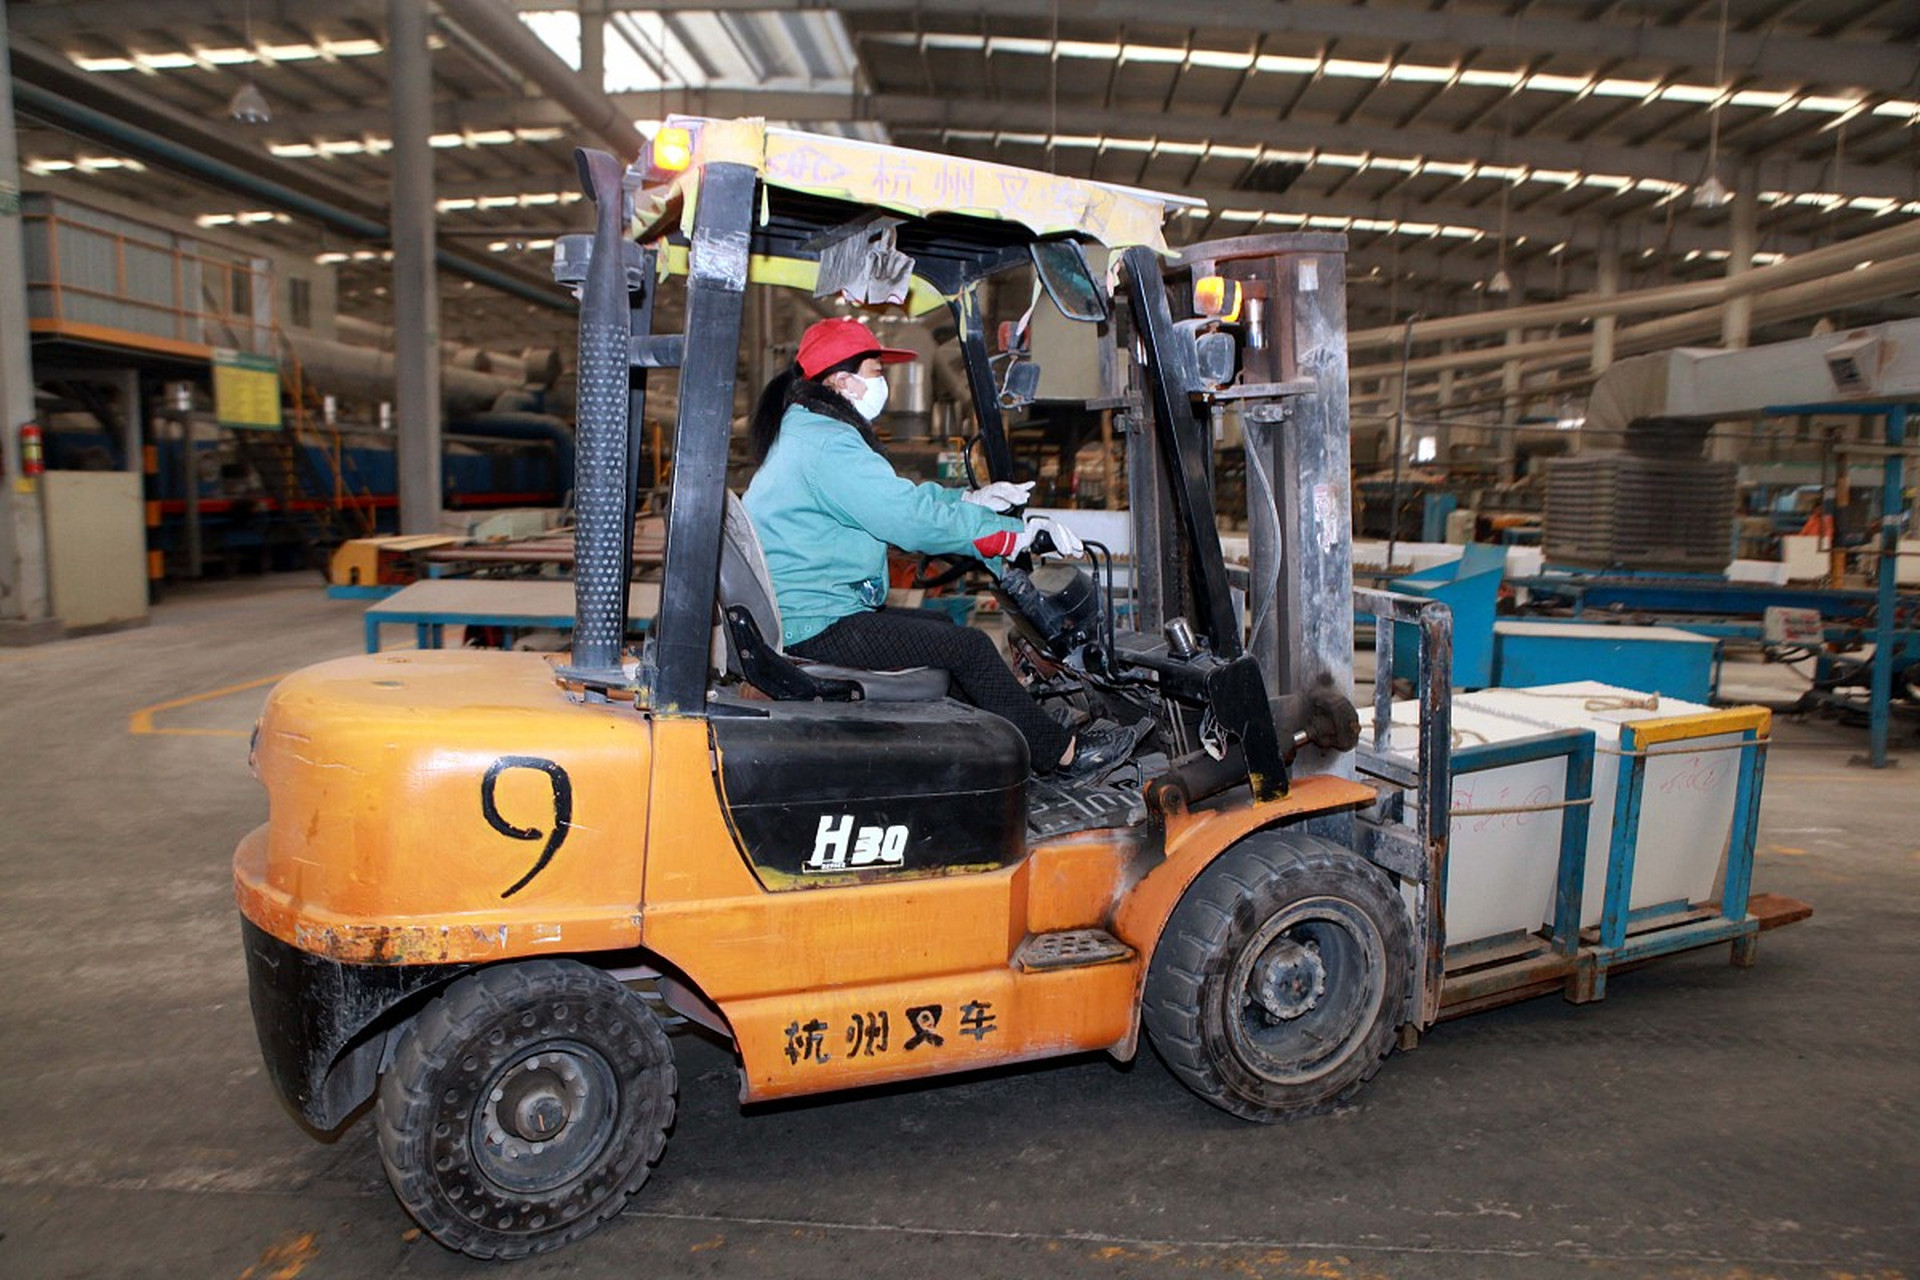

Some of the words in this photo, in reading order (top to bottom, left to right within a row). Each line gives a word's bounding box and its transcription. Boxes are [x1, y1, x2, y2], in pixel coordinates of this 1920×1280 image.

[481, 756, 572, 899] 9
[784, 1000, 998, 1065] 杭州叉车
